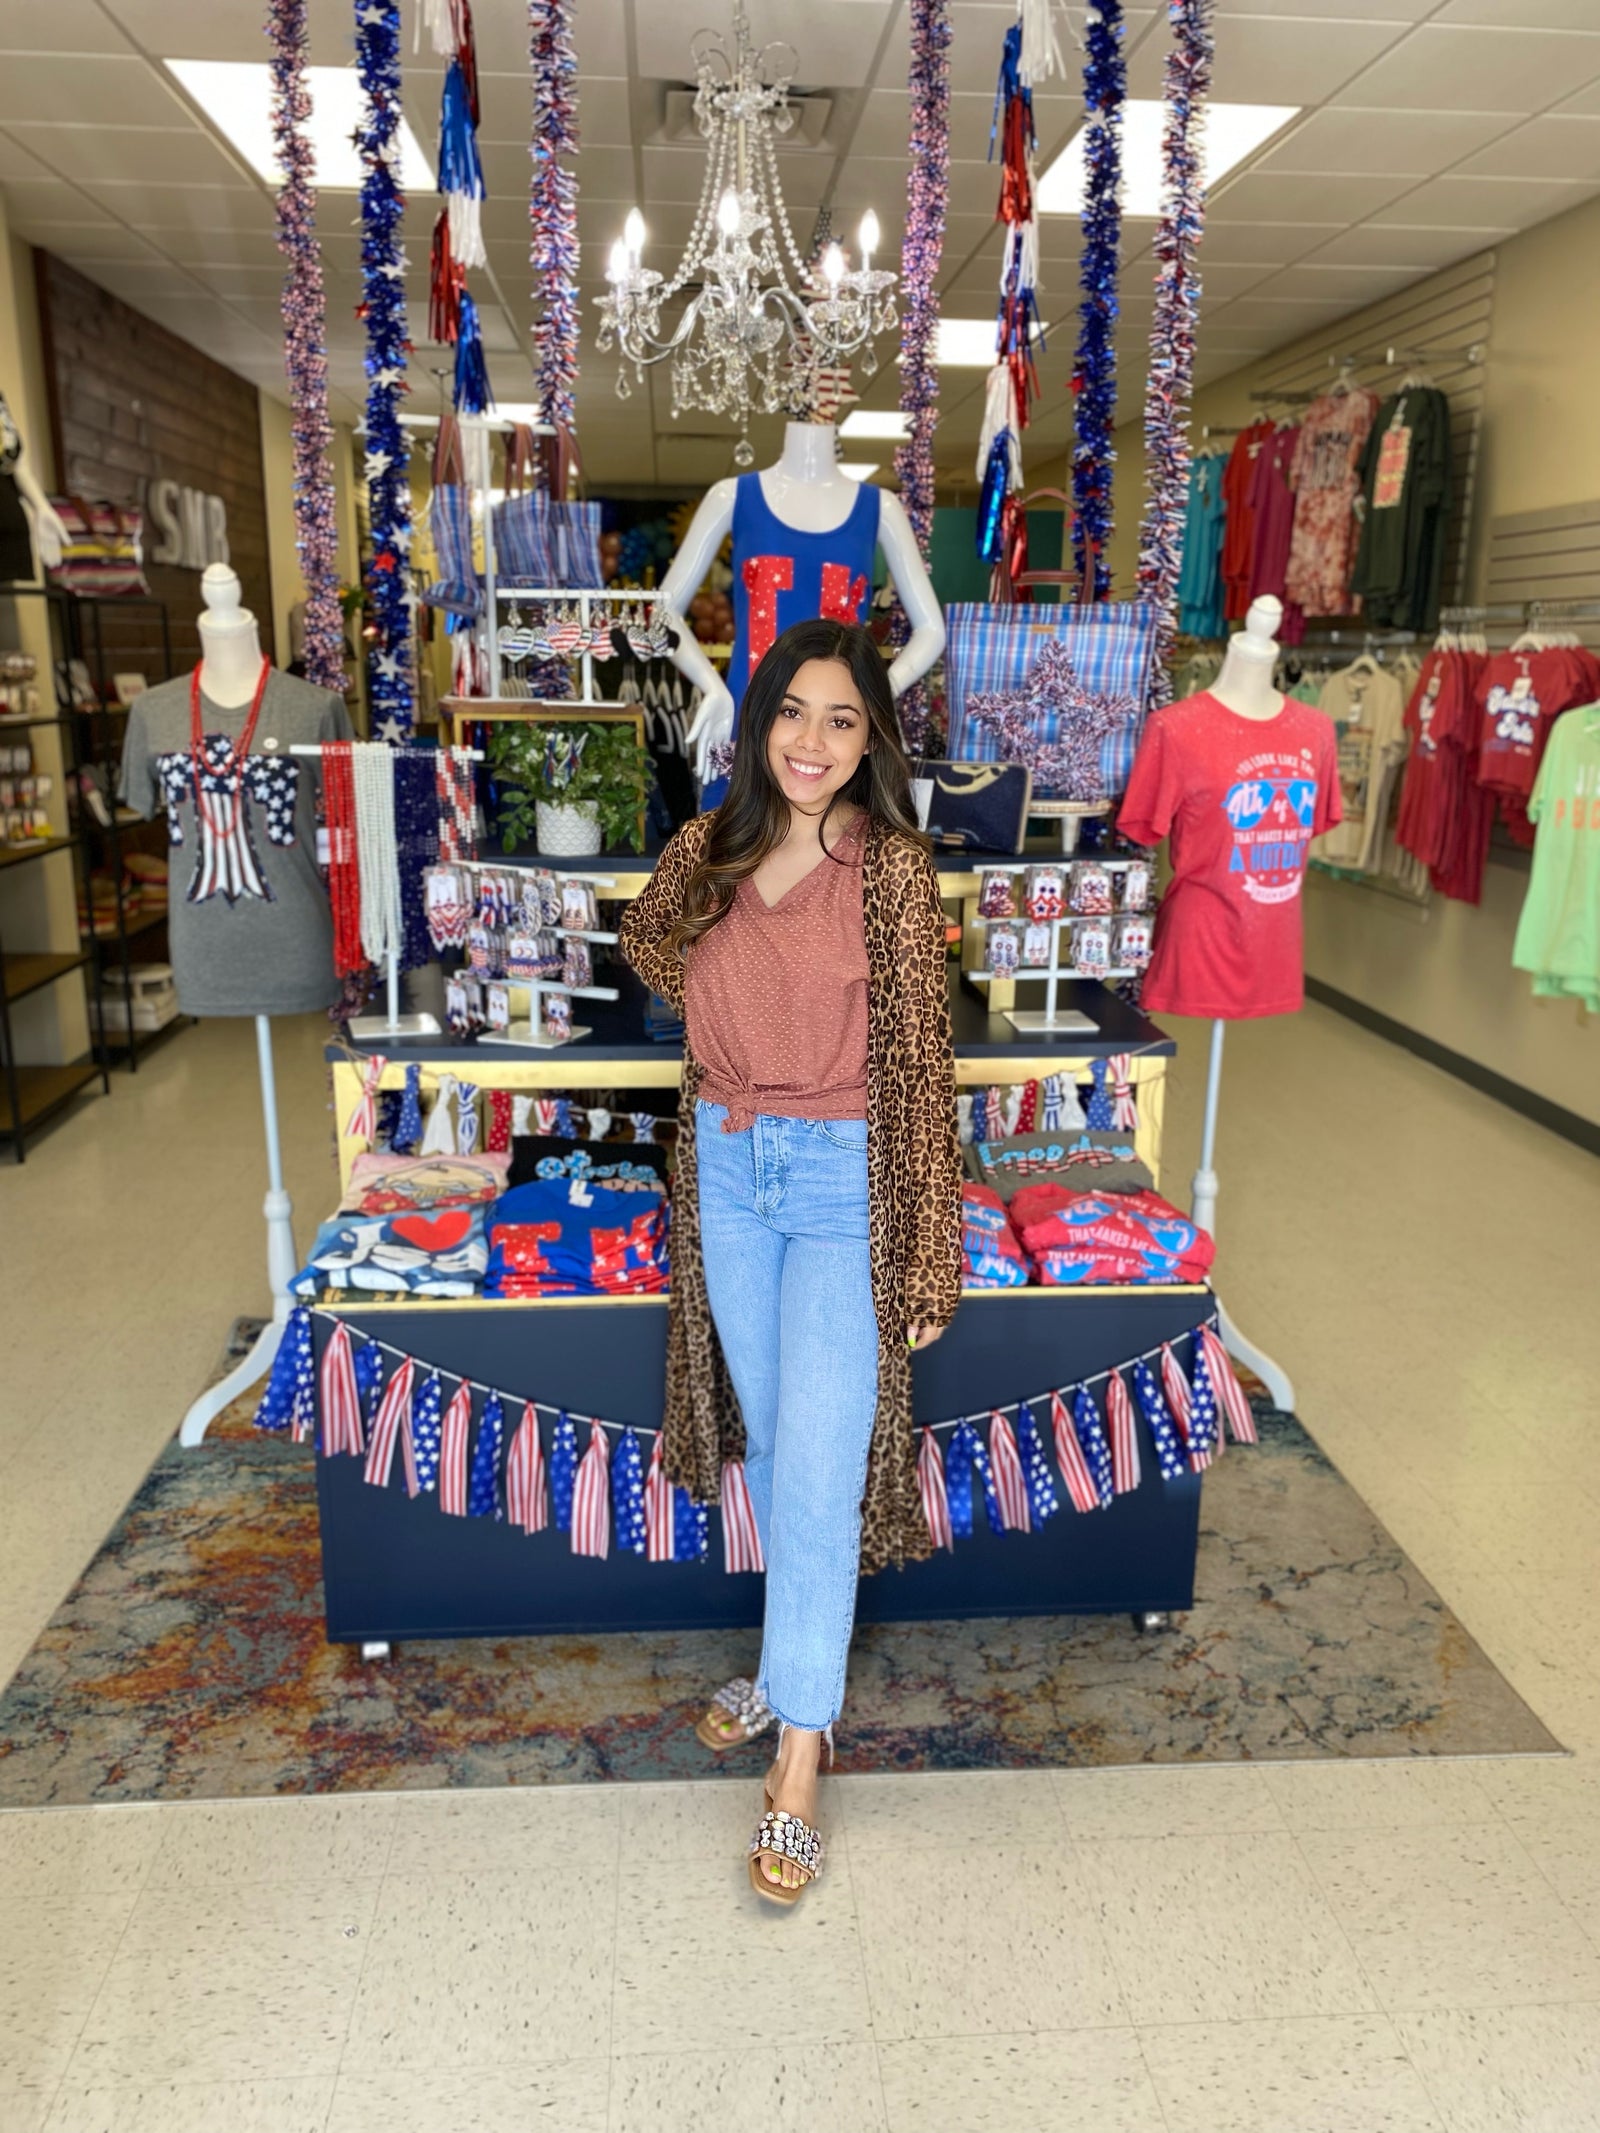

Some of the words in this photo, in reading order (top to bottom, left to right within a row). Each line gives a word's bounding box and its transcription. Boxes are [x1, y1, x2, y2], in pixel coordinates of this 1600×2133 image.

[1236, 760, 1254, 777] YOU
[1251, 753, 1276, 768] LOOK
[1277, 754, 1298, 768] LIKE
[1233, 831, 1254, 844] THAT
[1256, 829, 1282, 843] MAKES
[1229, 844, 1245, 873] A
[978, 1135, 1140, 1178] Freedom
[1067, 1227, 1096, 1244] THAT
